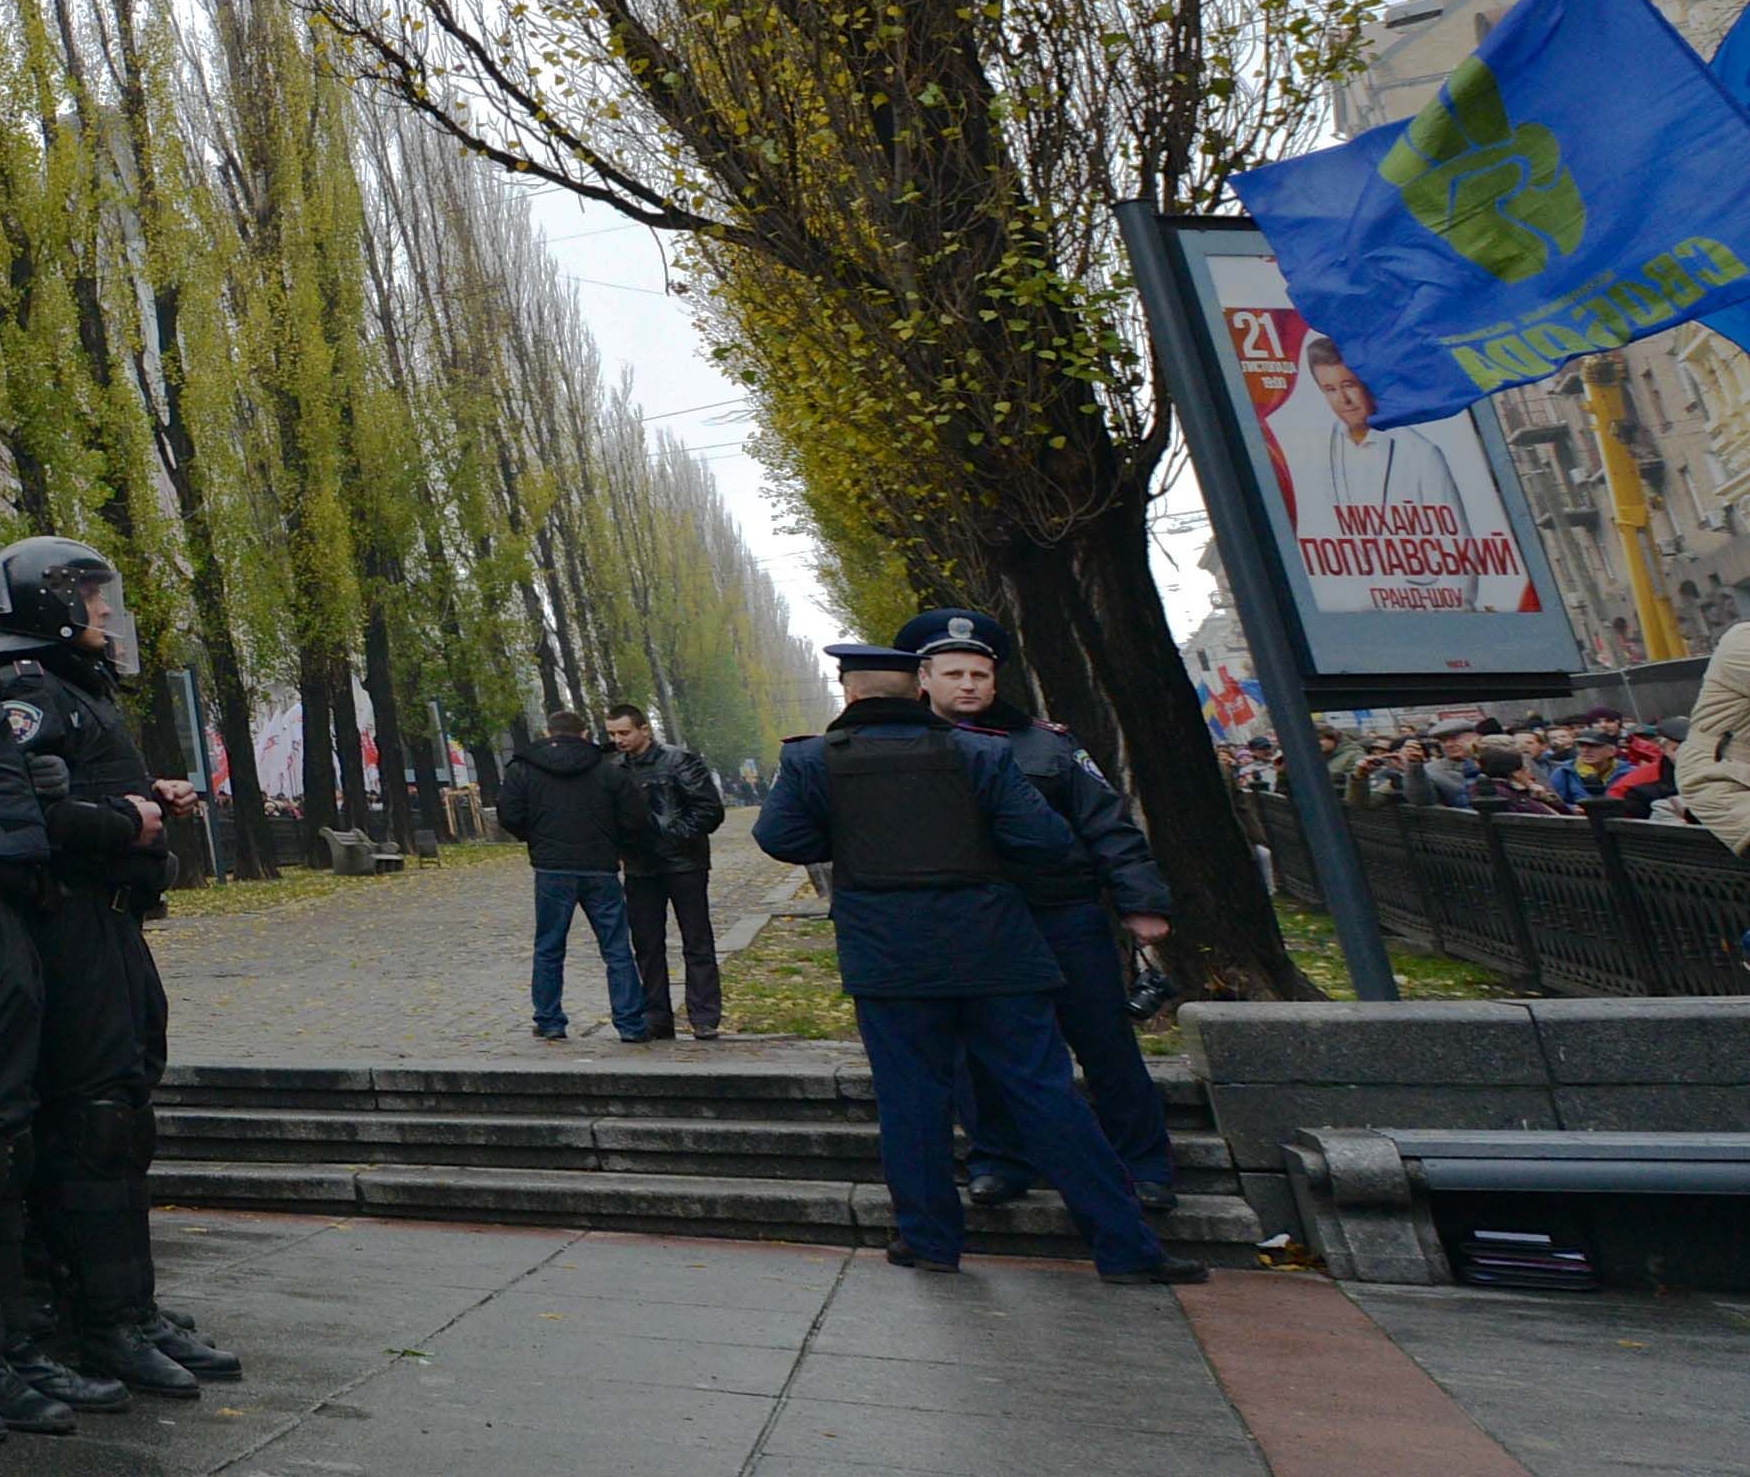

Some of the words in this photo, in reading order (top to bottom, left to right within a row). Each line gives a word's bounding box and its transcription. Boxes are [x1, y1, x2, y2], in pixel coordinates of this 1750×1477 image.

[1233, 311, 1285, 358] 21
[1333, 500, 1459, 536] МИХАЙЛО
[1299, 532, 1520, 577] ПОПЛАВСЬКИЙ
[1369, 587, 1464, 610] ГРАНД-ШОУ
